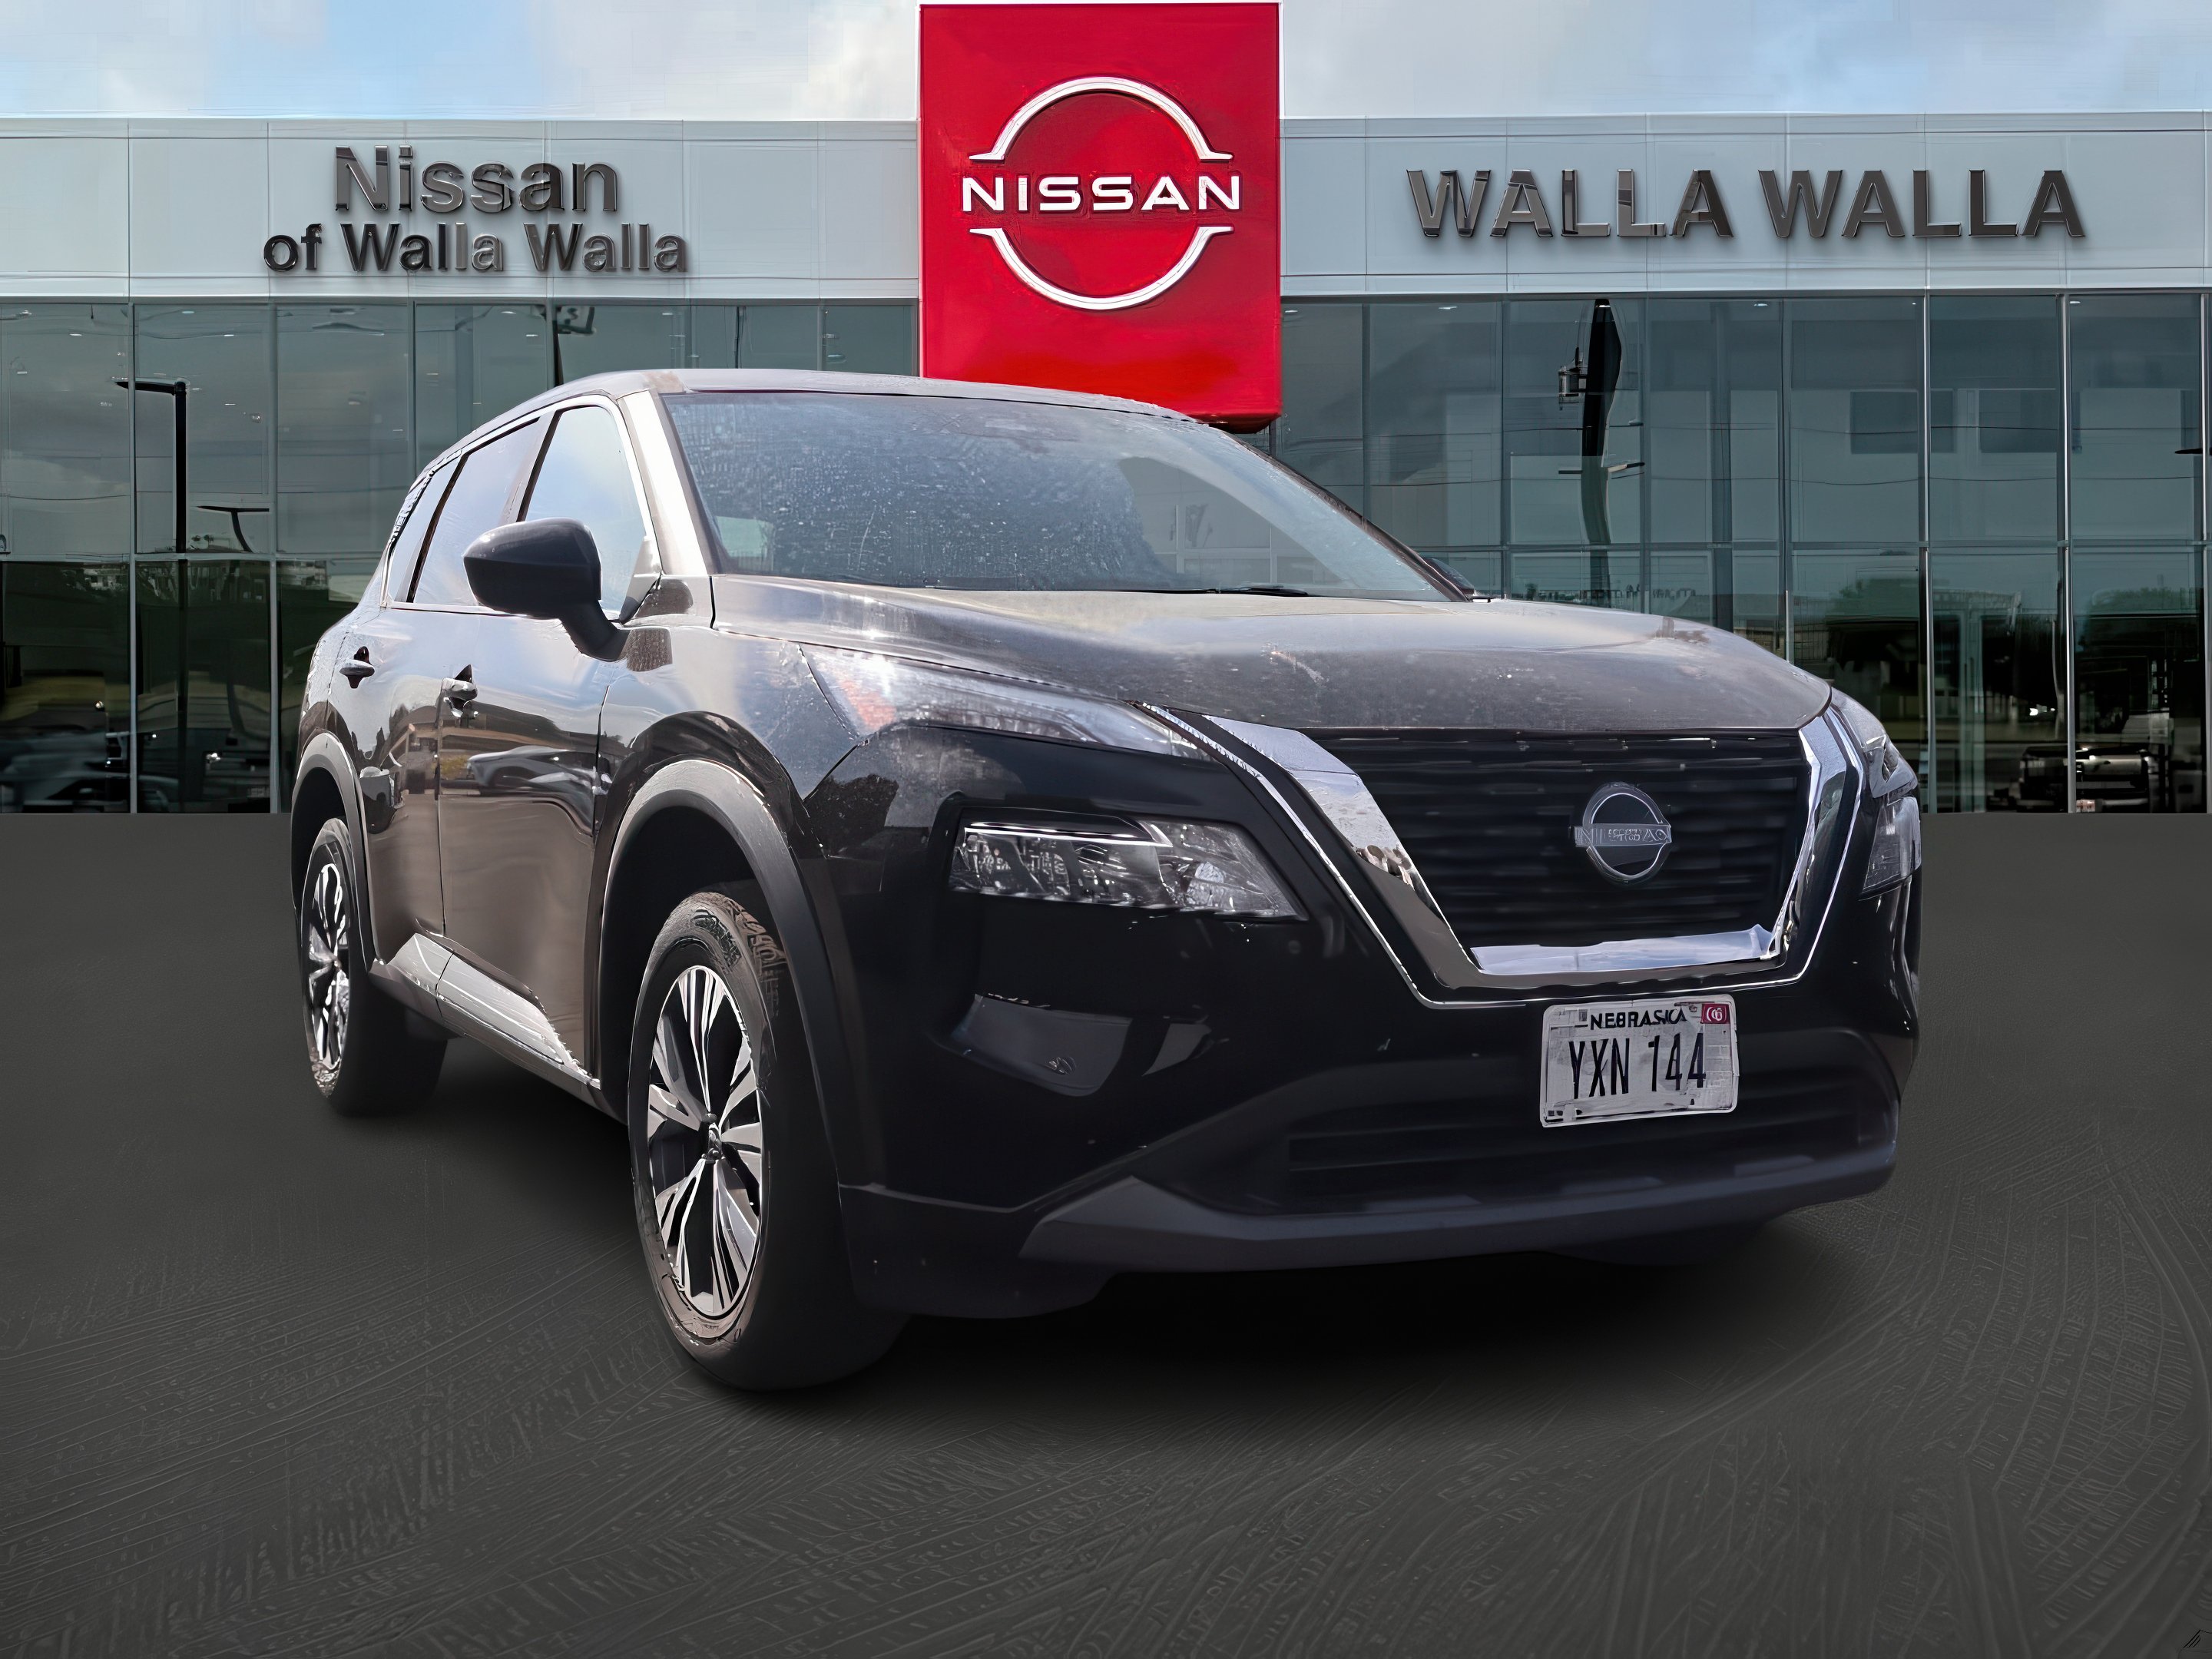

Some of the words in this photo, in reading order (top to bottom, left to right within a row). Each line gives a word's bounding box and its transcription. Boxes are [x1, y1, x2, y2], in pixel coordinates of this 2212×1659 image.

[335, 144, 618, 213] Nissan
[962, 174, 1242, 212] NISSAN
[1406, 169, 1734, 238] WALLA
[1758, 169, 2085, 238] WALLA
[263, 223, 323, 272] of
[339, 222, 505, 272] Walla
[523, 222, 686, 272] Walla
[1568, 1037, 1631, 1100] YXN
[1647, 1032, 1707, 1092] 144
